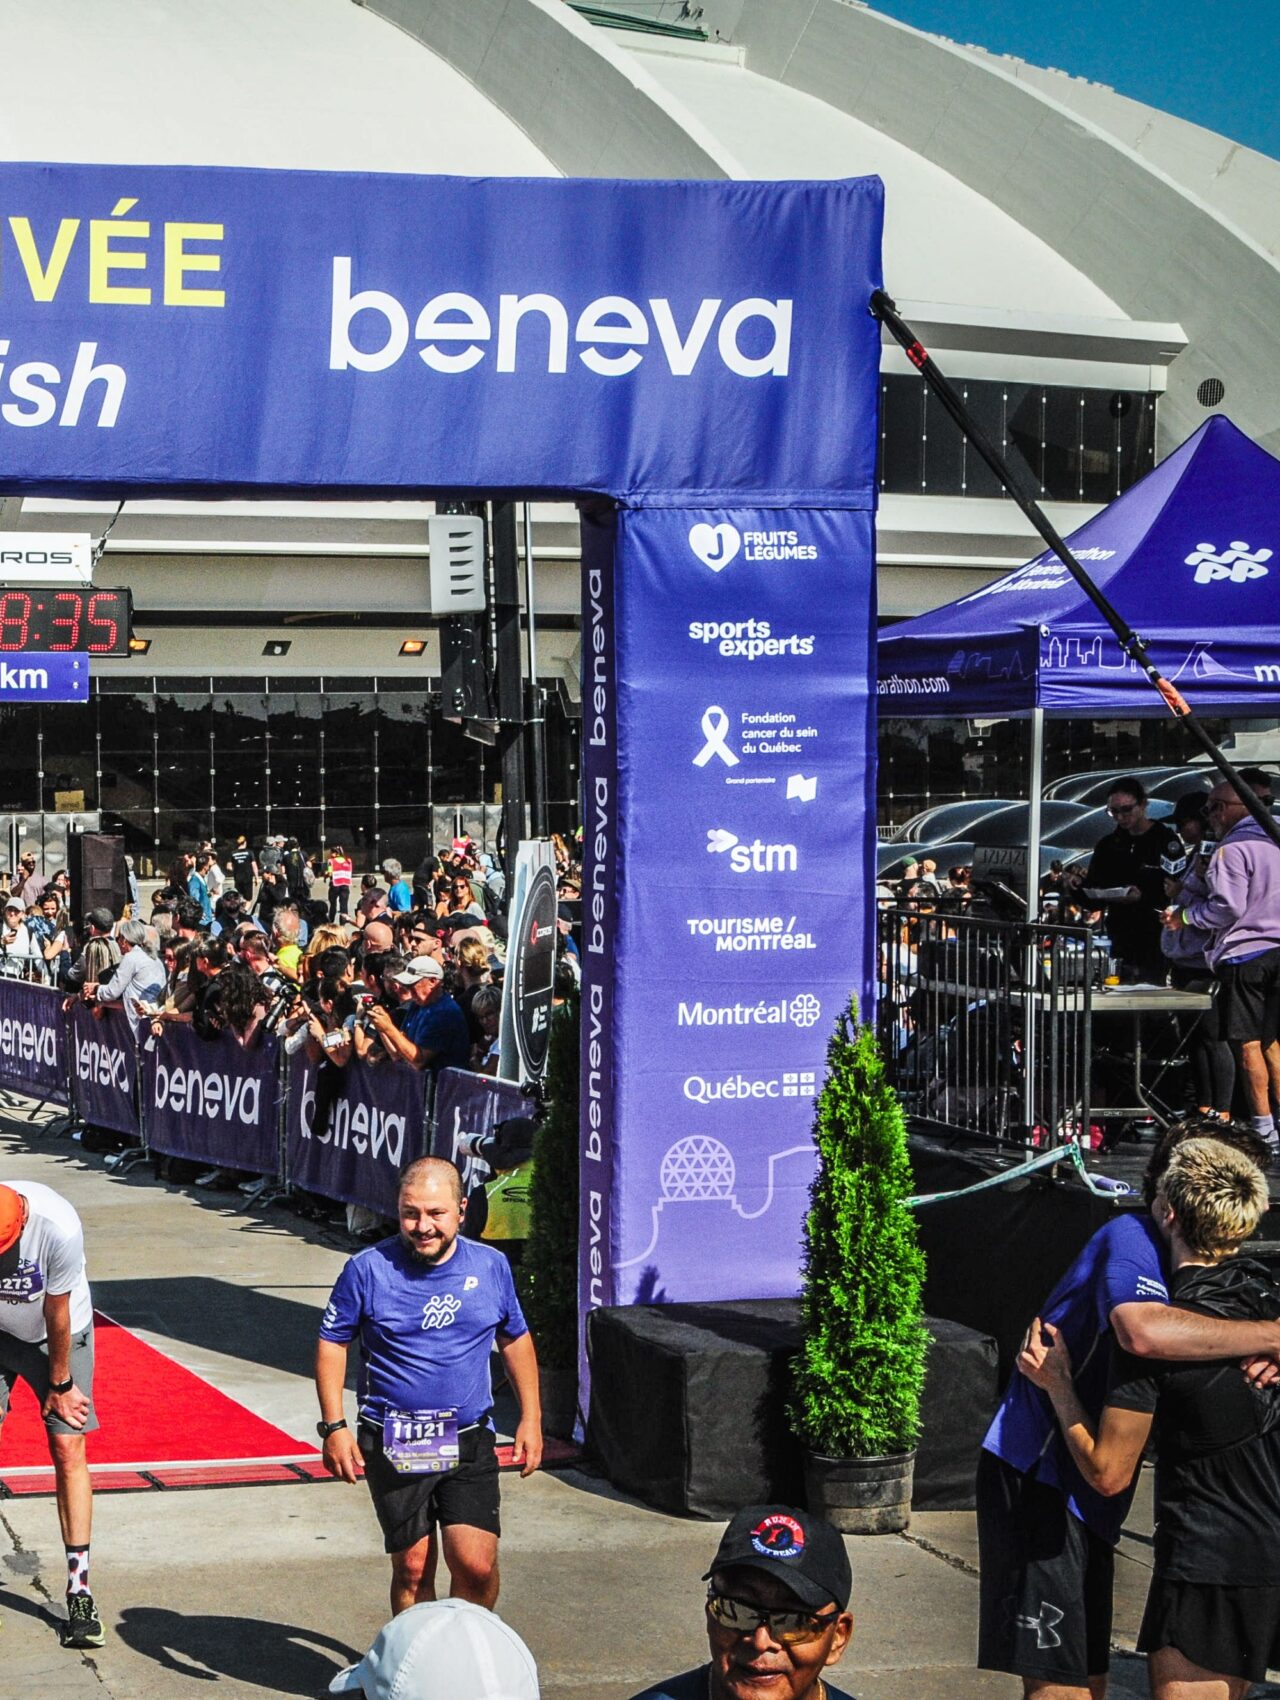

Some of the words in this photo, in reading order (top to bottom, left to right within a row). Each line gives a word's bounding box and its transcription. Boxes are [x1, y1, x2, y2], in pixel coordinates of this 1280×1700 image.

[329, 256, 793, 377] beneva
[743, 531, 798, 545] FRUITS
[688, 618, 771, 643] sports
[588, 569, 607, 746] beneva
[718, 634, 815, 660] experts
[0, 662, 48, 690] km
[877, 674, 950, 695] arathon.com
[741, 713, 796, 724] Fondation
[741, 729, 777, 738] cancer
[779, 726, 794, 738] du
[796, 726, 818, 738] sein
[742, 743, 757, 754] du
[758, 742, 802, 754] Québec
[588, 777, 608, 954] beneva
[730, 839, 798, 873] stm
[678, 1000, 787, 1026] Montréal
[155, 1046, 261, 1125] beneva
[587, 984, 603, 1162] beneva
[683, 1075, 780, 1104] Québec
[392, 1421, 445, 1440] 11121
